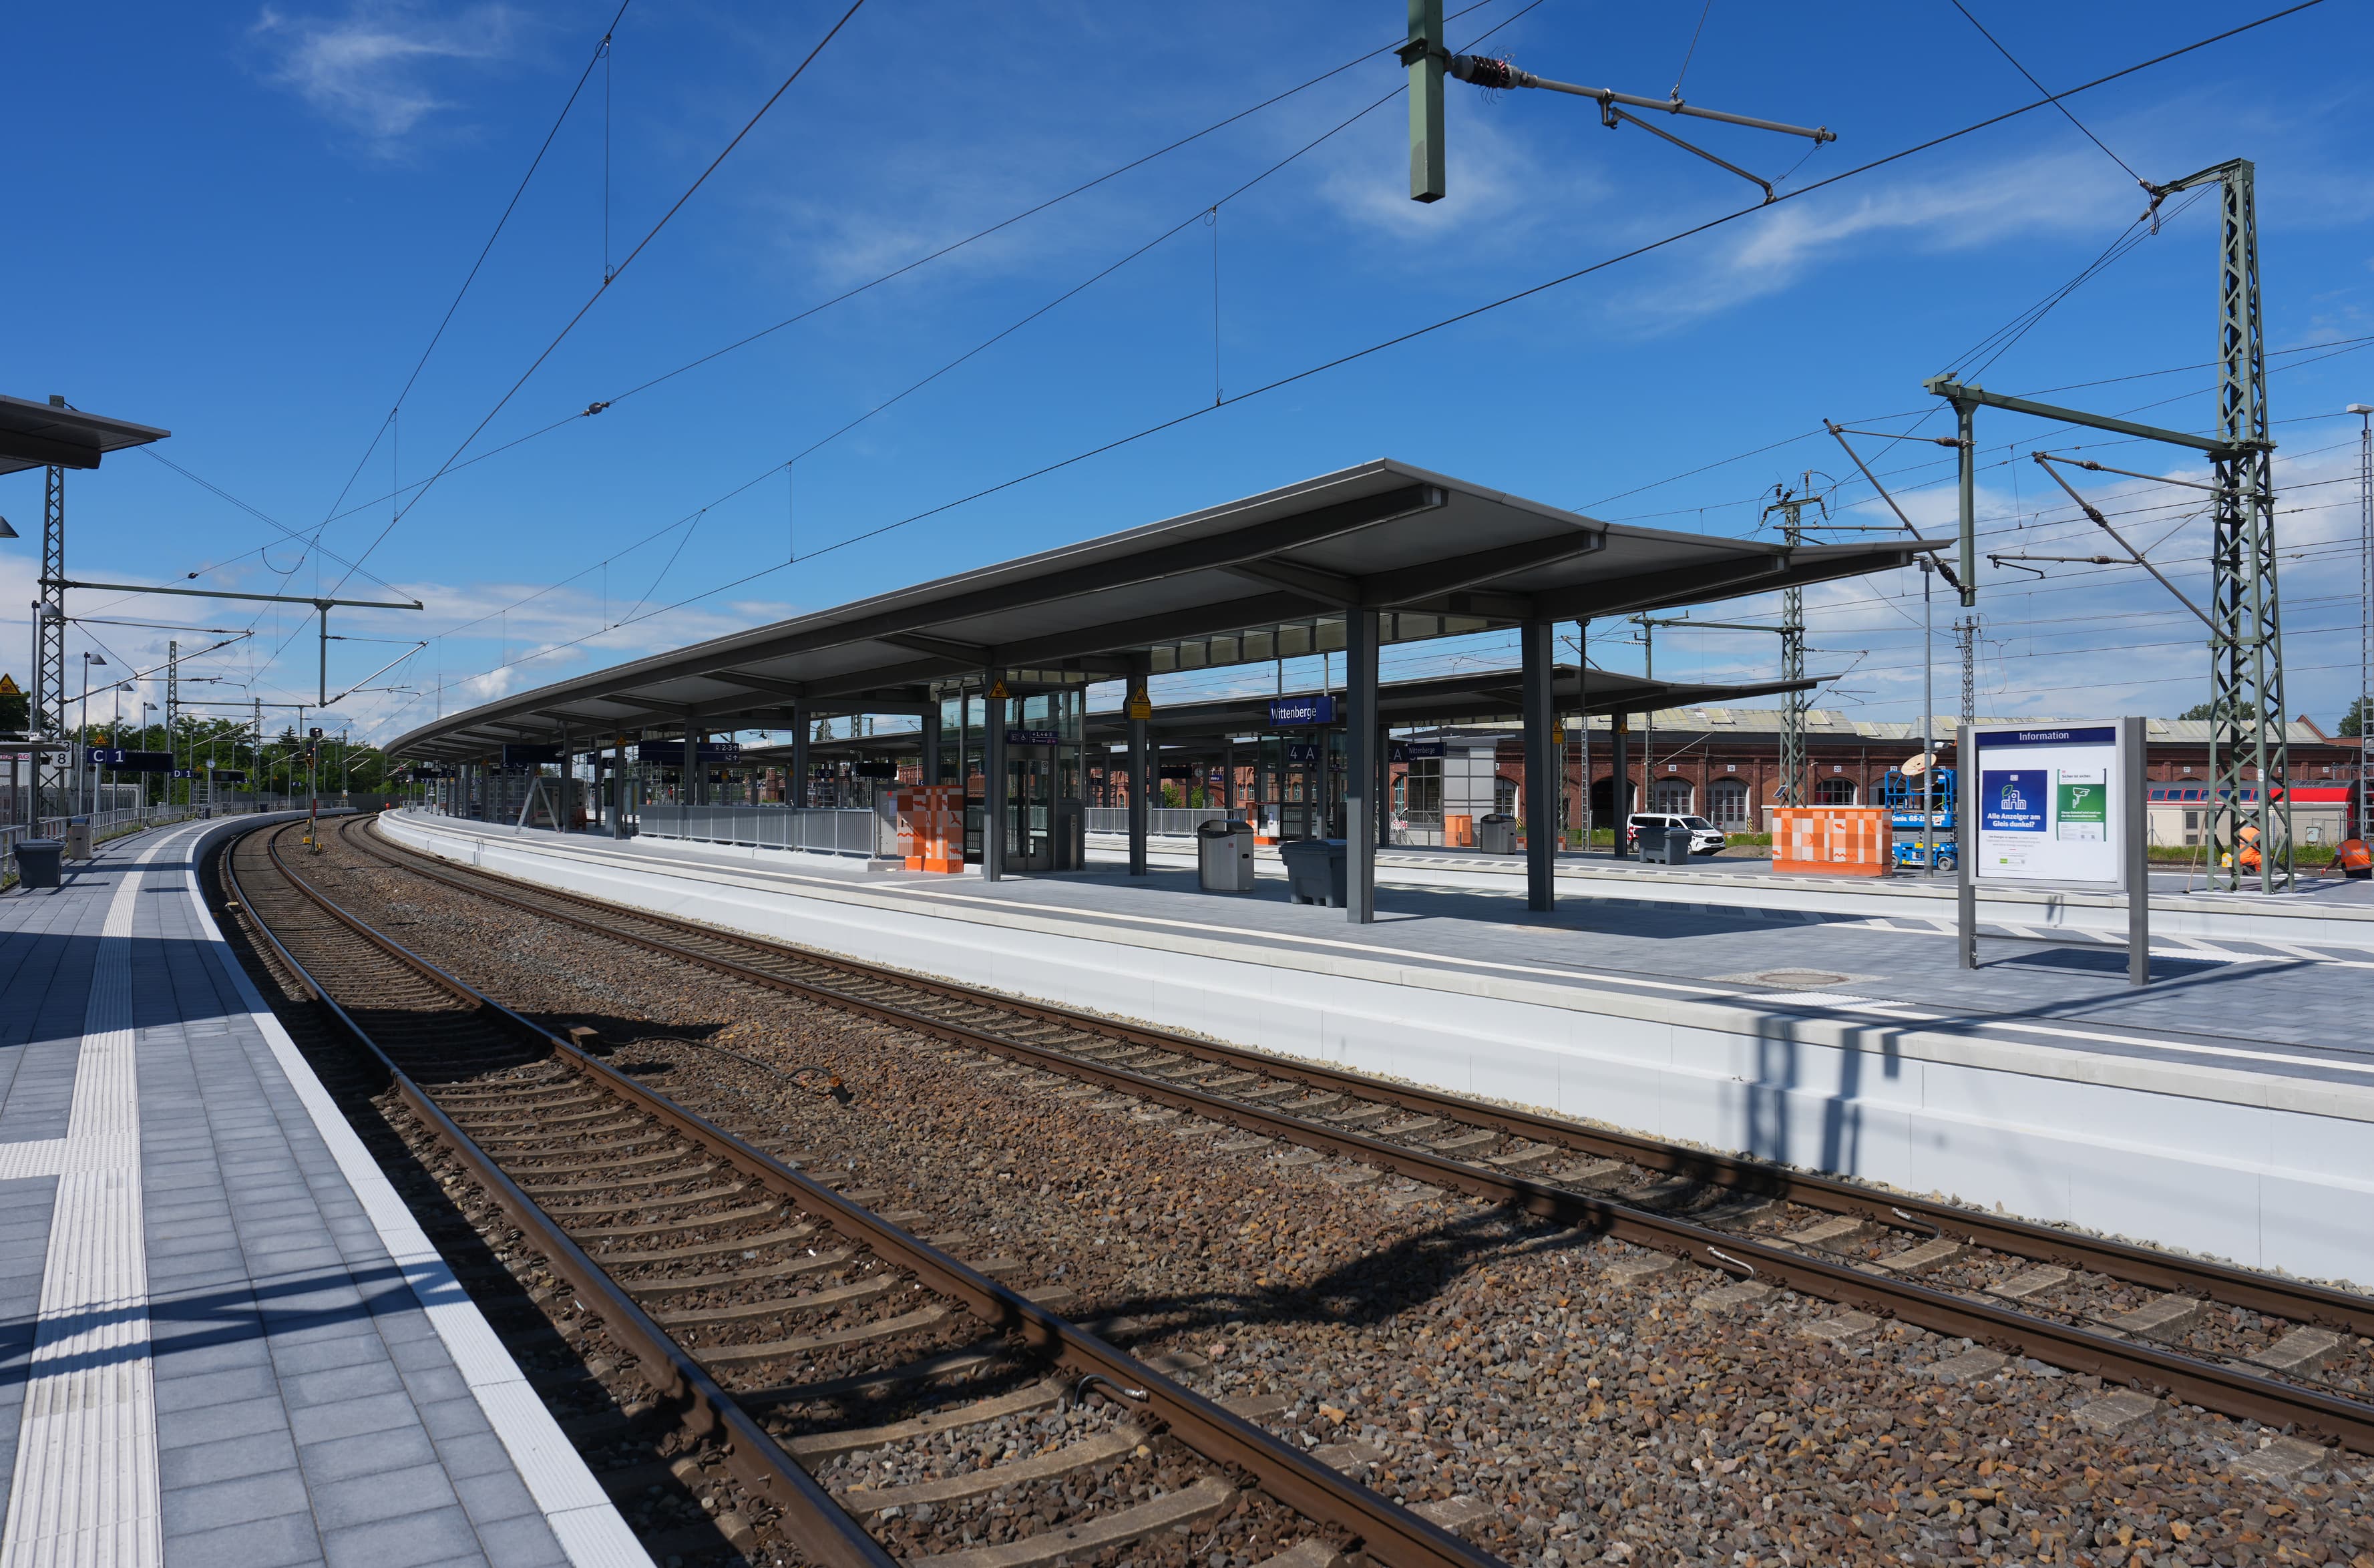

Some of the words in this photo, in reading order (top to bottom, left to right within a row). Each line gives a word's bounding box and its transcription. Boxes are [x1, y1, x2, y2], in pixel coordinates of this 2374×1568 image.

[1271, 705, 1317, 720] Wittenberge
[2019, 732, 2069, 741] Information
[93, 750, 104, 762] C
[116, 750, 124, 762] 1
[1290, 746, 1298, 759] 4
[1305, 747, 1315, 759] A
[1394, 747, 1402, 761] A
[1408, 746, 1436, 755] Wittenberge
[57, 753, 66, 764] 8
[607, 759, 614, 768] C
[2001, 813, 2029, 821] Anzeiger
